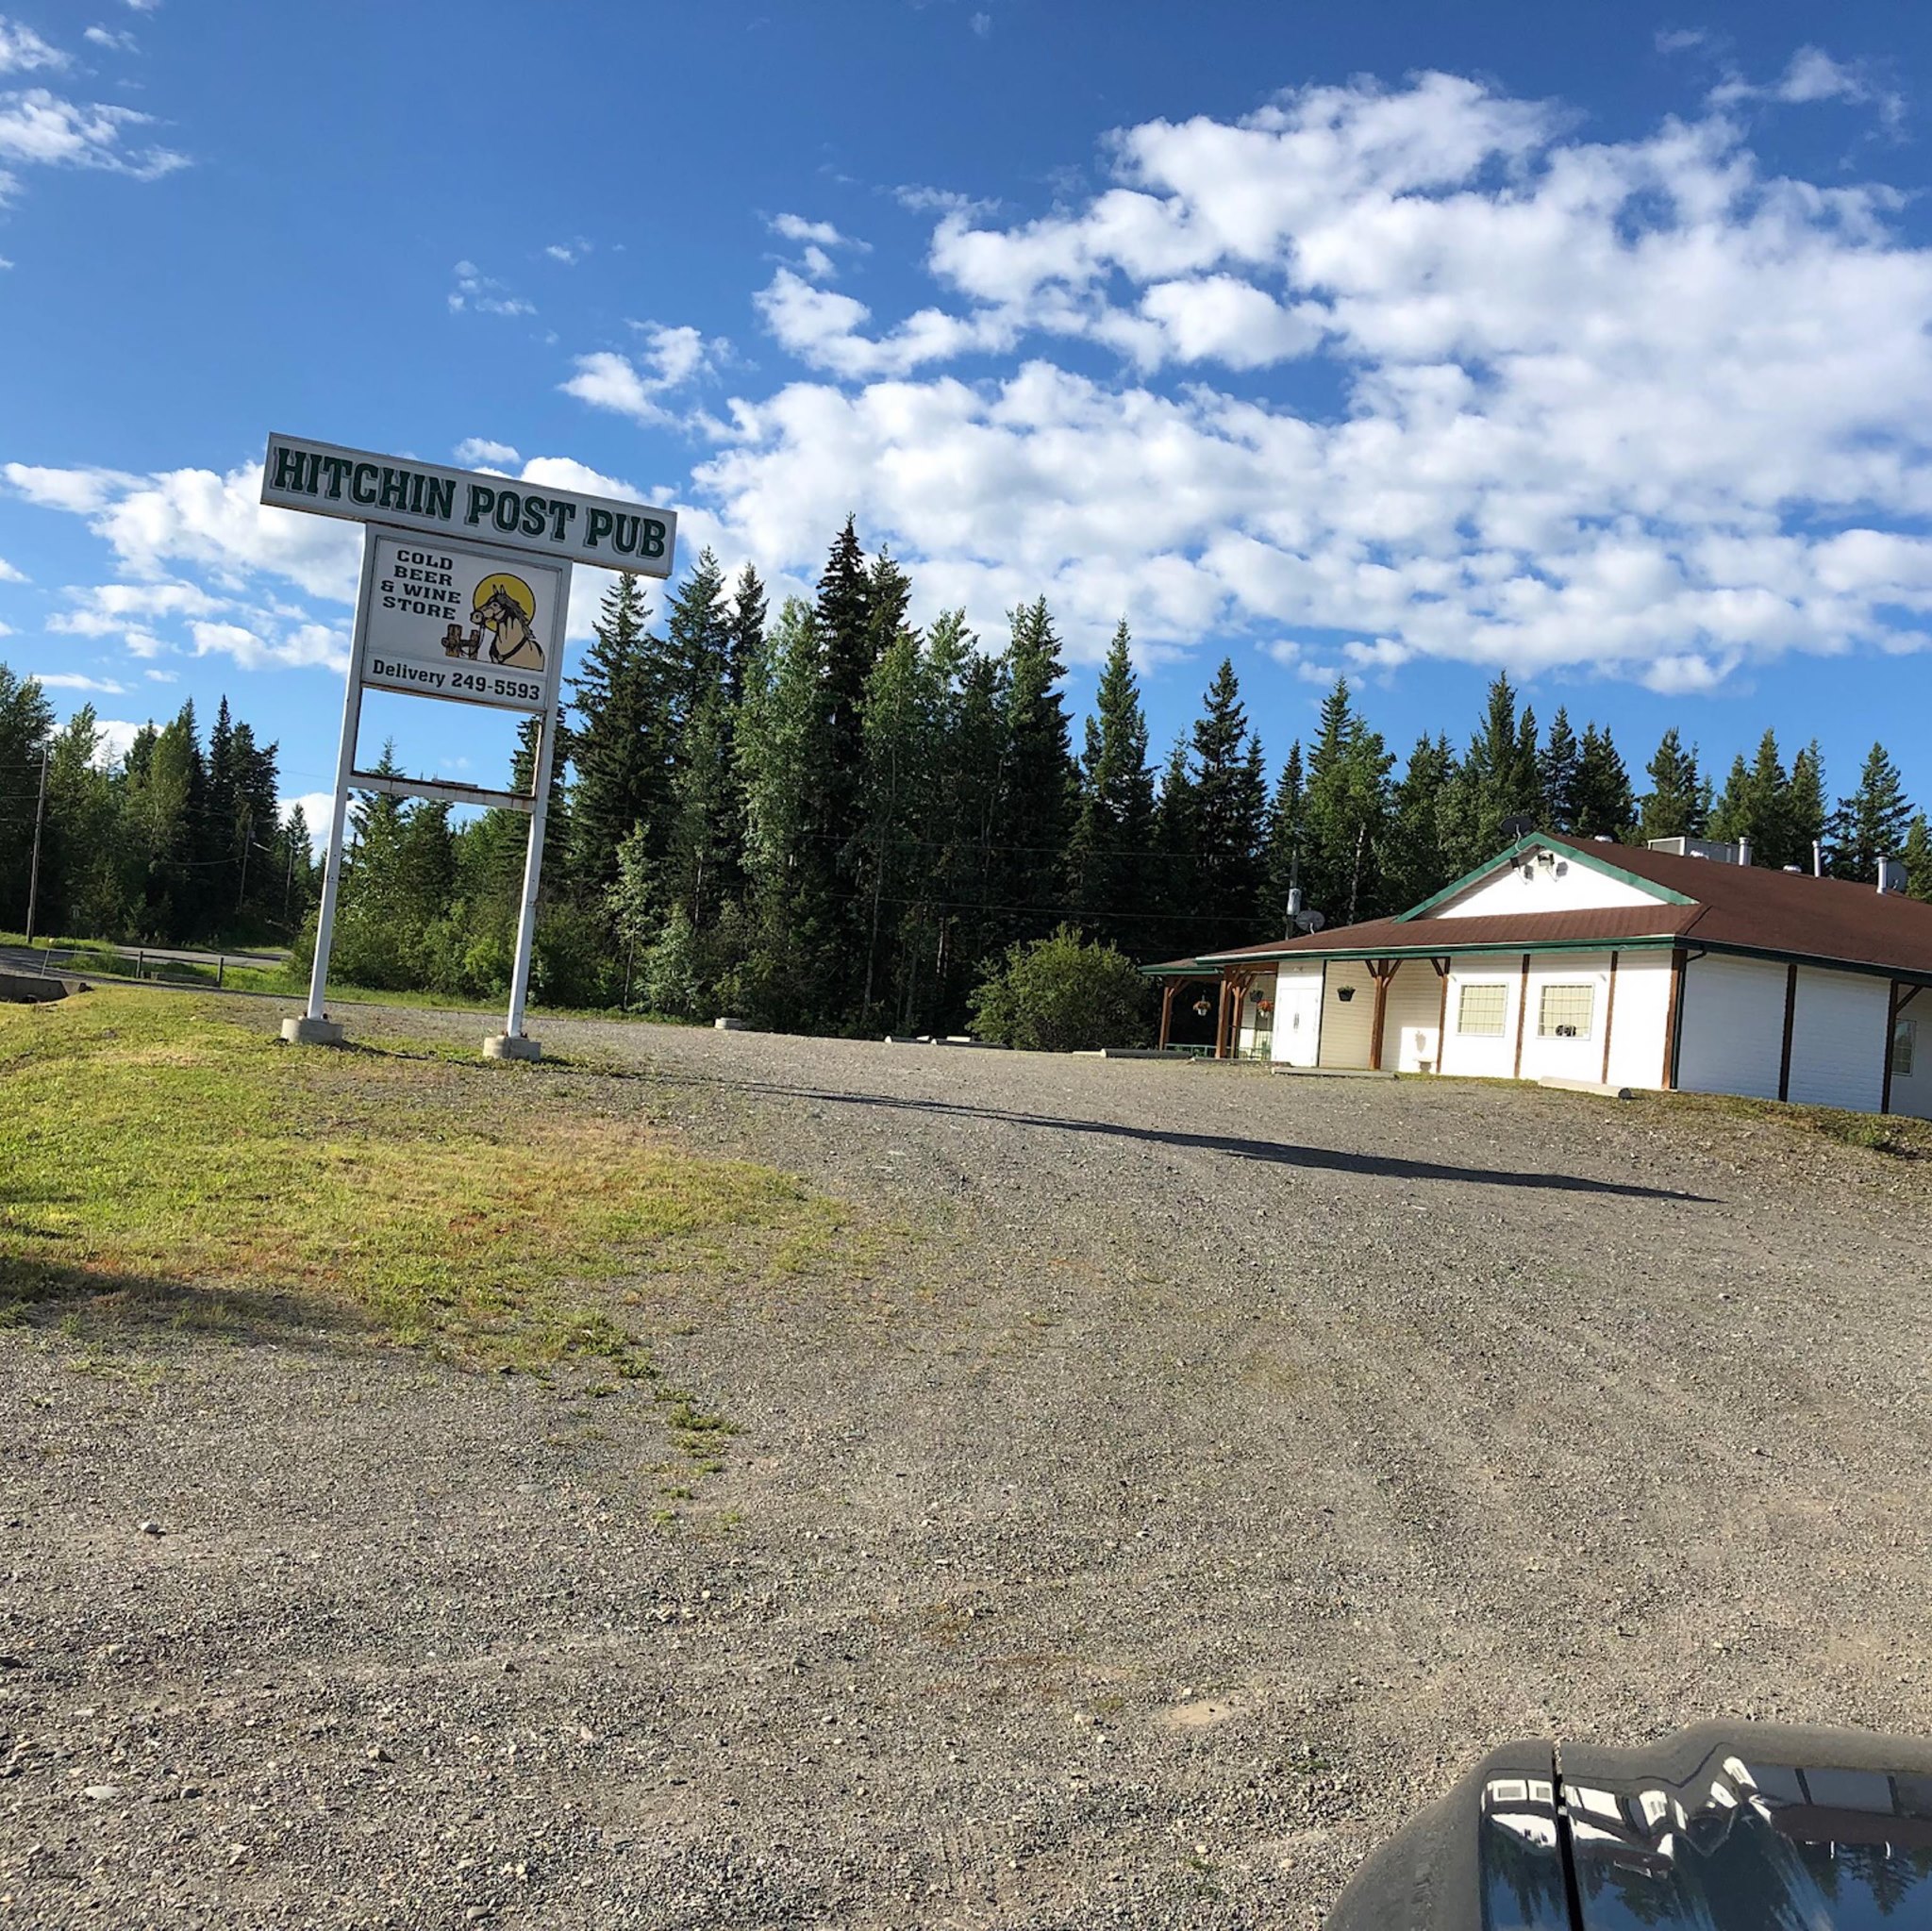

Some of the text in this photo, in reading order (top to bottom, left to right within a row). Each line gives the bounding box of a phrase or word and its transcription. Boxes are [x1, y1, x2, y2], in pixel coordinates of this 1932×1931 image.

[272, 446, 667, 559] HITCHIN POST PUB
[397, 550, 453, 570] COLD
[394, 565, 453, 586] BEER
[380, 580, 461, 604] & WINE
[383, 596, 456, 620] STORE
[373, 659, 540, 700] Delivery 249-5593
